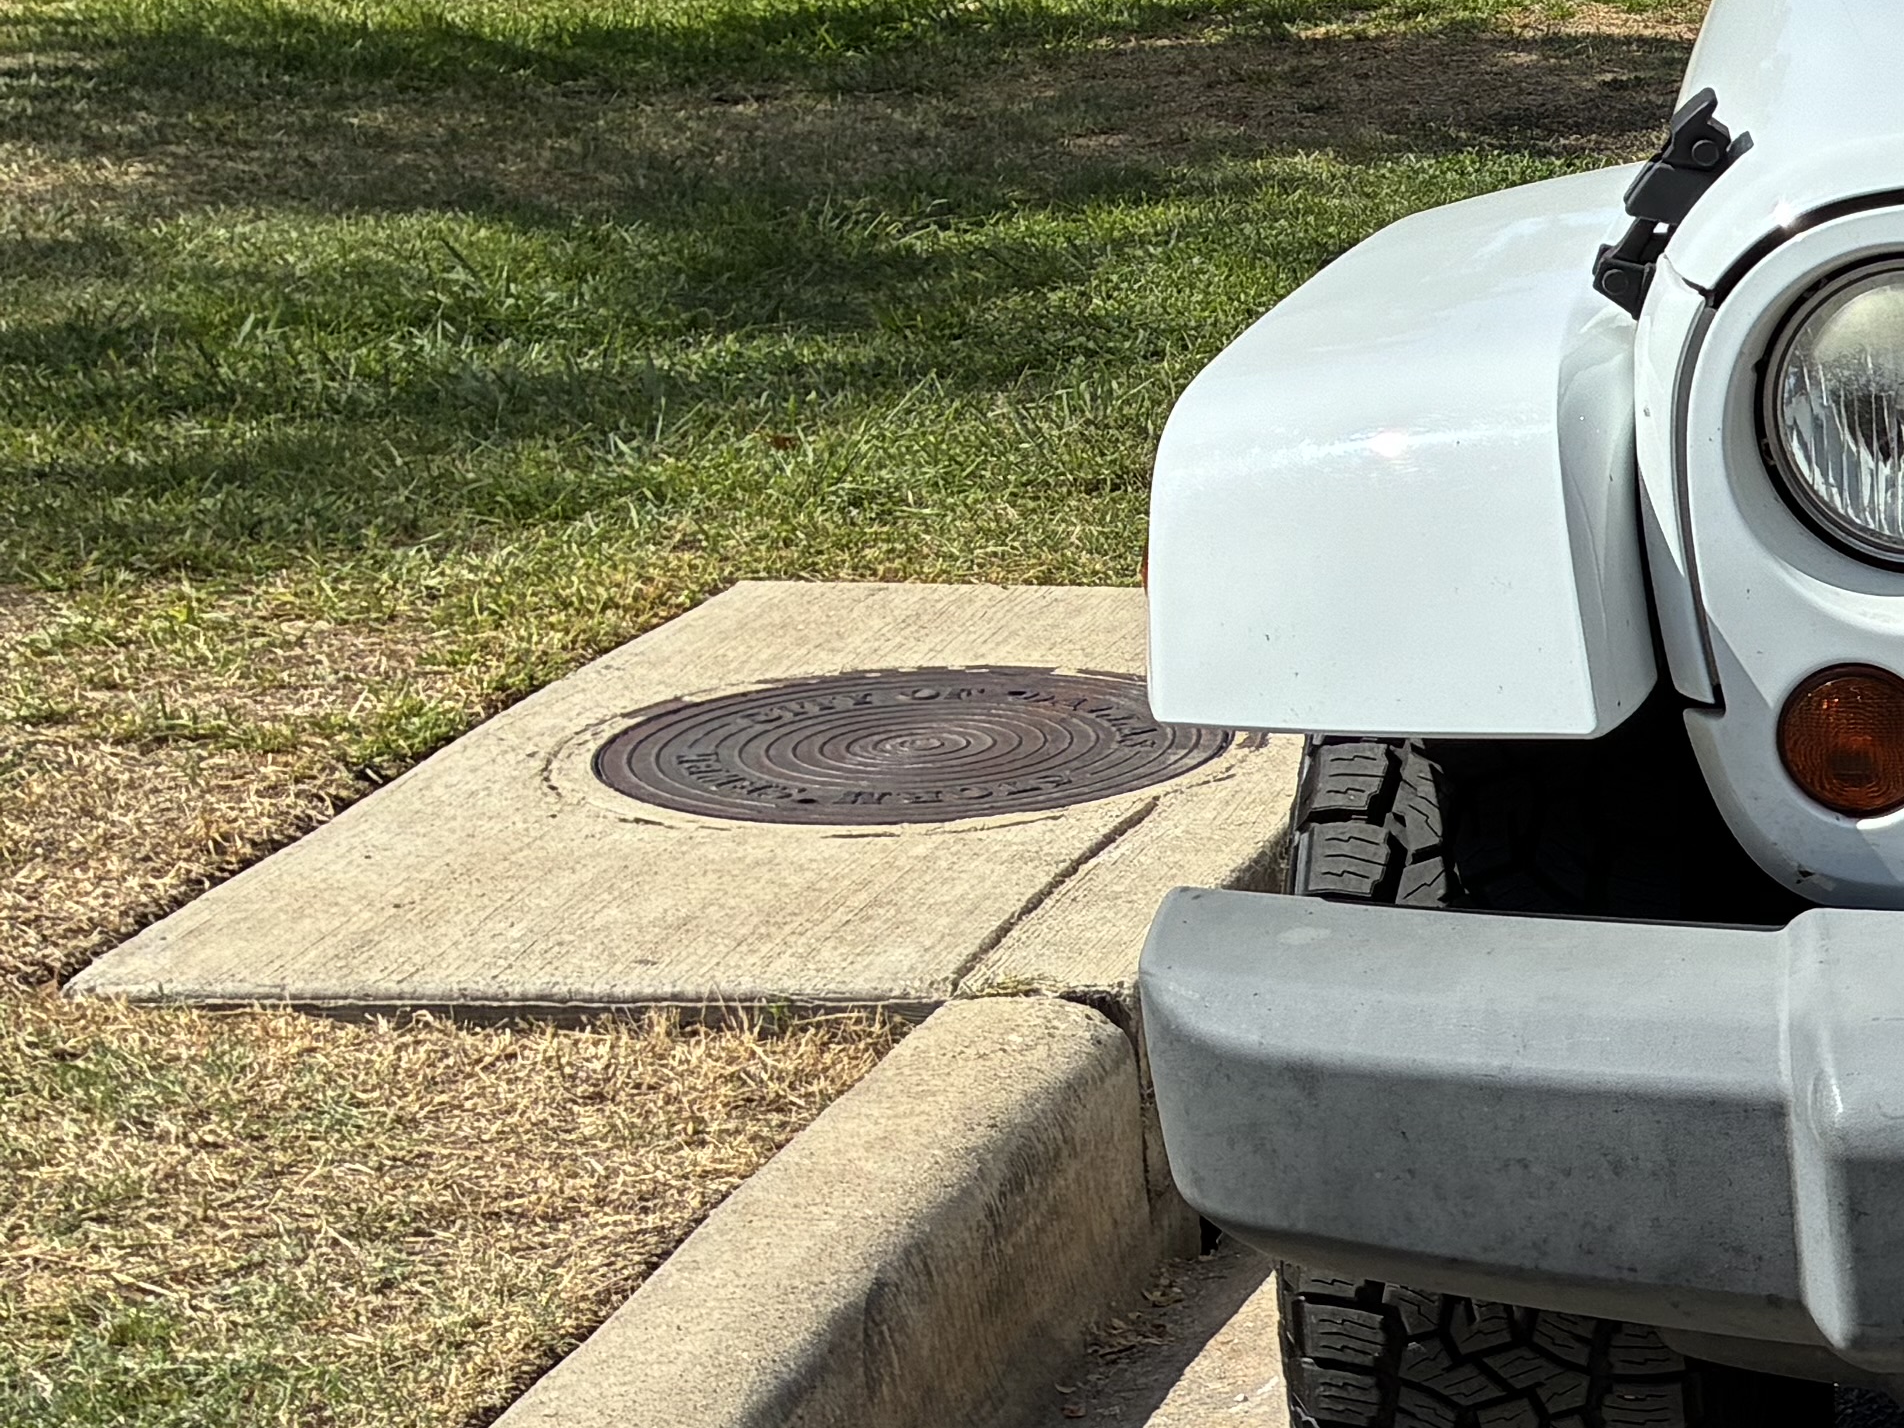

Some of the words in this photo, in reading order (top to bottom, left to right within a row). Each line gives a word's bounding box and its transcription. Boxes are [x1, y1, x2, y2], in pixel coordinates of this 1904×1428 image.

[737, 692, 873, 725] CITY
[896, 687, 986, 701] OF
[1020, 691, 1157, 749] DALLAS
